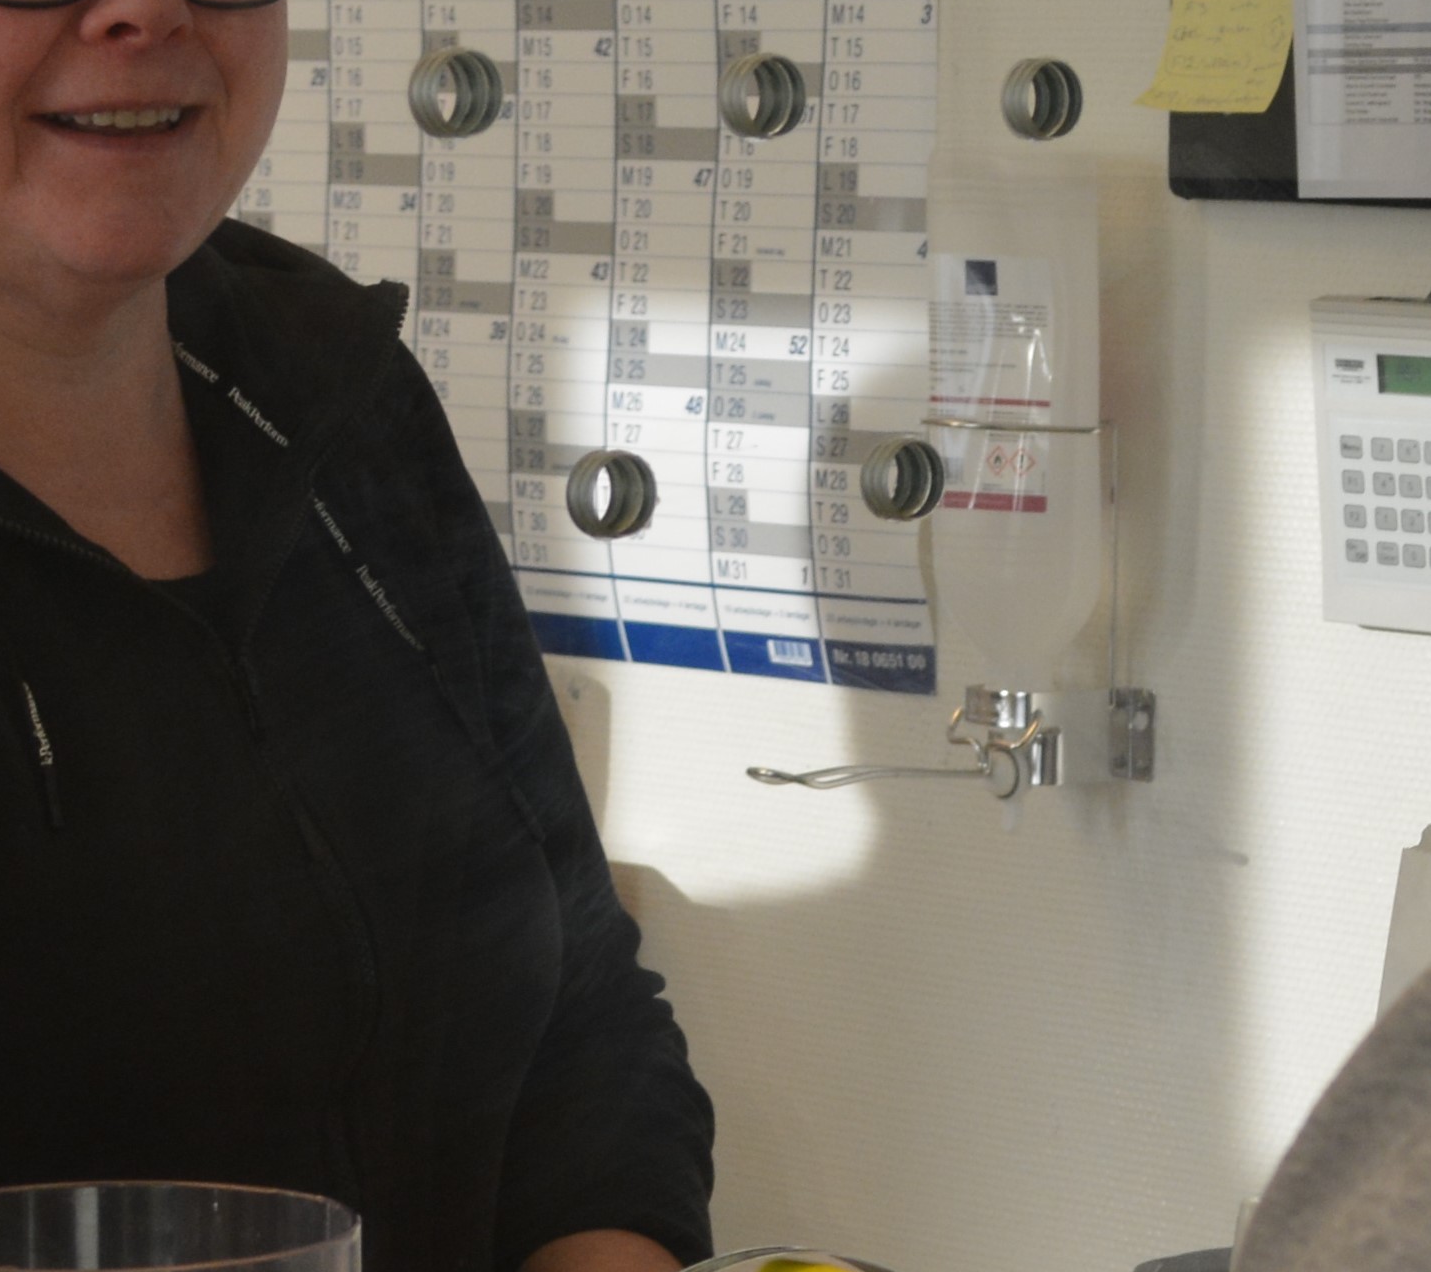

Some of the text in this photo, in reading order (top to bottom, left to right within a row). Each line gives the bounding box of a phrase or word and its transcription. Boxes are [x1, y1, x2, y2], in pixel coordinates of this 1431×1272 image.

[723, 6, 757, 24] F 14
[921, 4, 933, 25] 3
[594, 38, 611, 57] 42
[831, 39, 864, 58] T 15
[827, 104, 859, 123] T 17
[694, 168, 712, 186] 47
[722, 168, 753, 188] O 19
[400, 194, 416, 211] 34
[720, 201, 750, 220] T 20
[719, 234, 727, 252] F
[731, 234, 748, 252] 21
[917, 240, 928, 258] 4
[591, 262, 609, 280] 43
[819, 270, 851, 289] T 22
[617, 296, 647, 314] F 23
[788, 336, 808, 355] 52
[817, 336, 849, 356] T 24
[818, 370, 850, 389] F 25
[685, 396, 703, 414] 48
[713, 430, 743, 448] T 27
[713, 463, 743, 482] F 28
[800, 566, 808, 586] 1
[832, 648, 851, 664] Nr.
